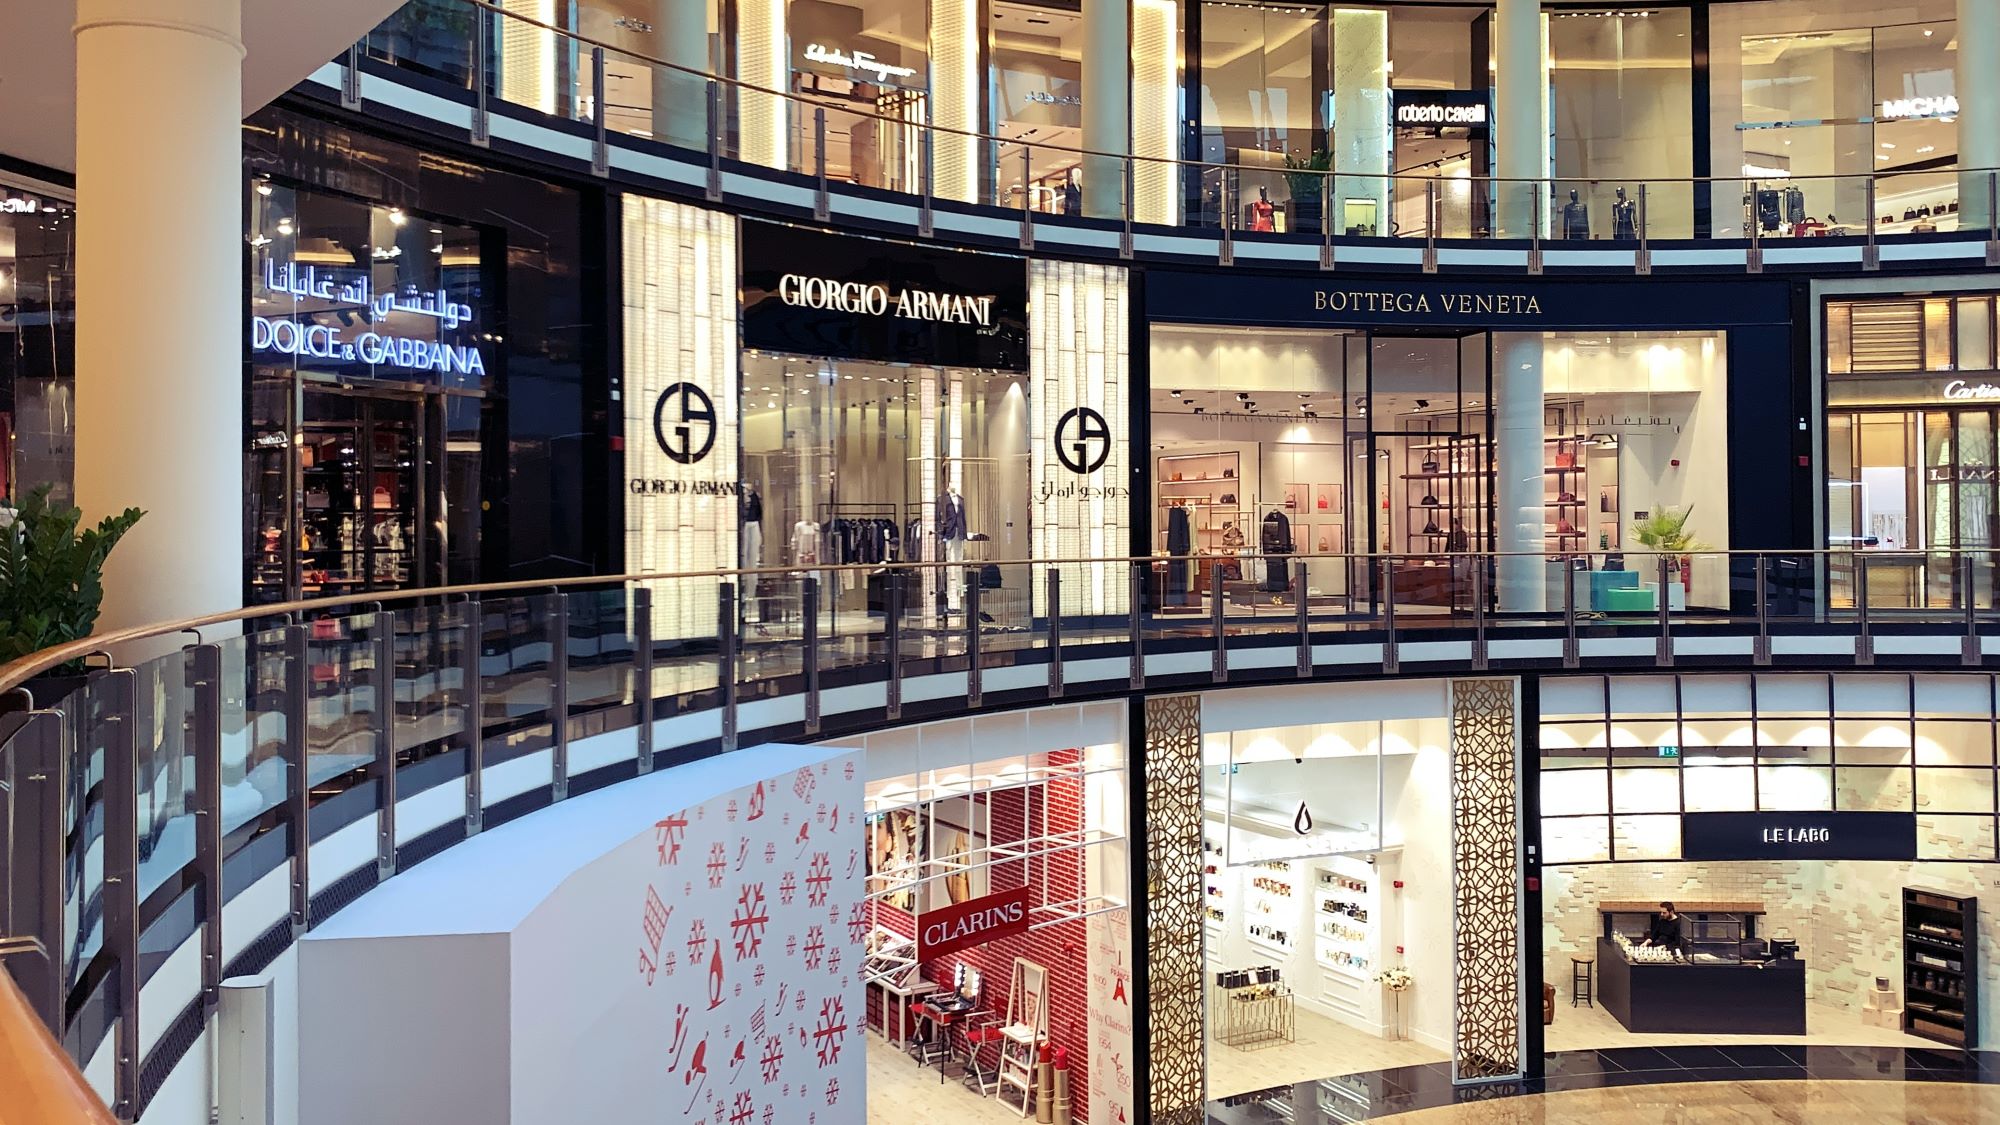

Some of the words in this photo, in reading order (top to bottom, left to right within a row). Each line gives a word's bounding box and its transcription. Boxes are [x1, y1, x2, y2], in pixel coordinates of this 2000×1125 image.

[1398, 104, 1444, 122] roberto
[1444, 104, 1486, 122] cavalli
[779, 273, 888, 316] GIORGIO
[894, 288, 991, 326] ARMANI
[1314, 290, 1432, 313] BOTTEGA
[1440, 293, 1542, 314] VENETA
[630, 478, 687, 494] GIORGIO
[690, 480, 739, 496] ARMANI
[1763, 827, 1785, 843] LE
[1788, 827, 1830, 843] LABO
[924, 901, 1024, 946] CLARINS
[1089, 1006, 1104, 1026] Why
[1104, 1014, 1131, 1036] Clarins?
